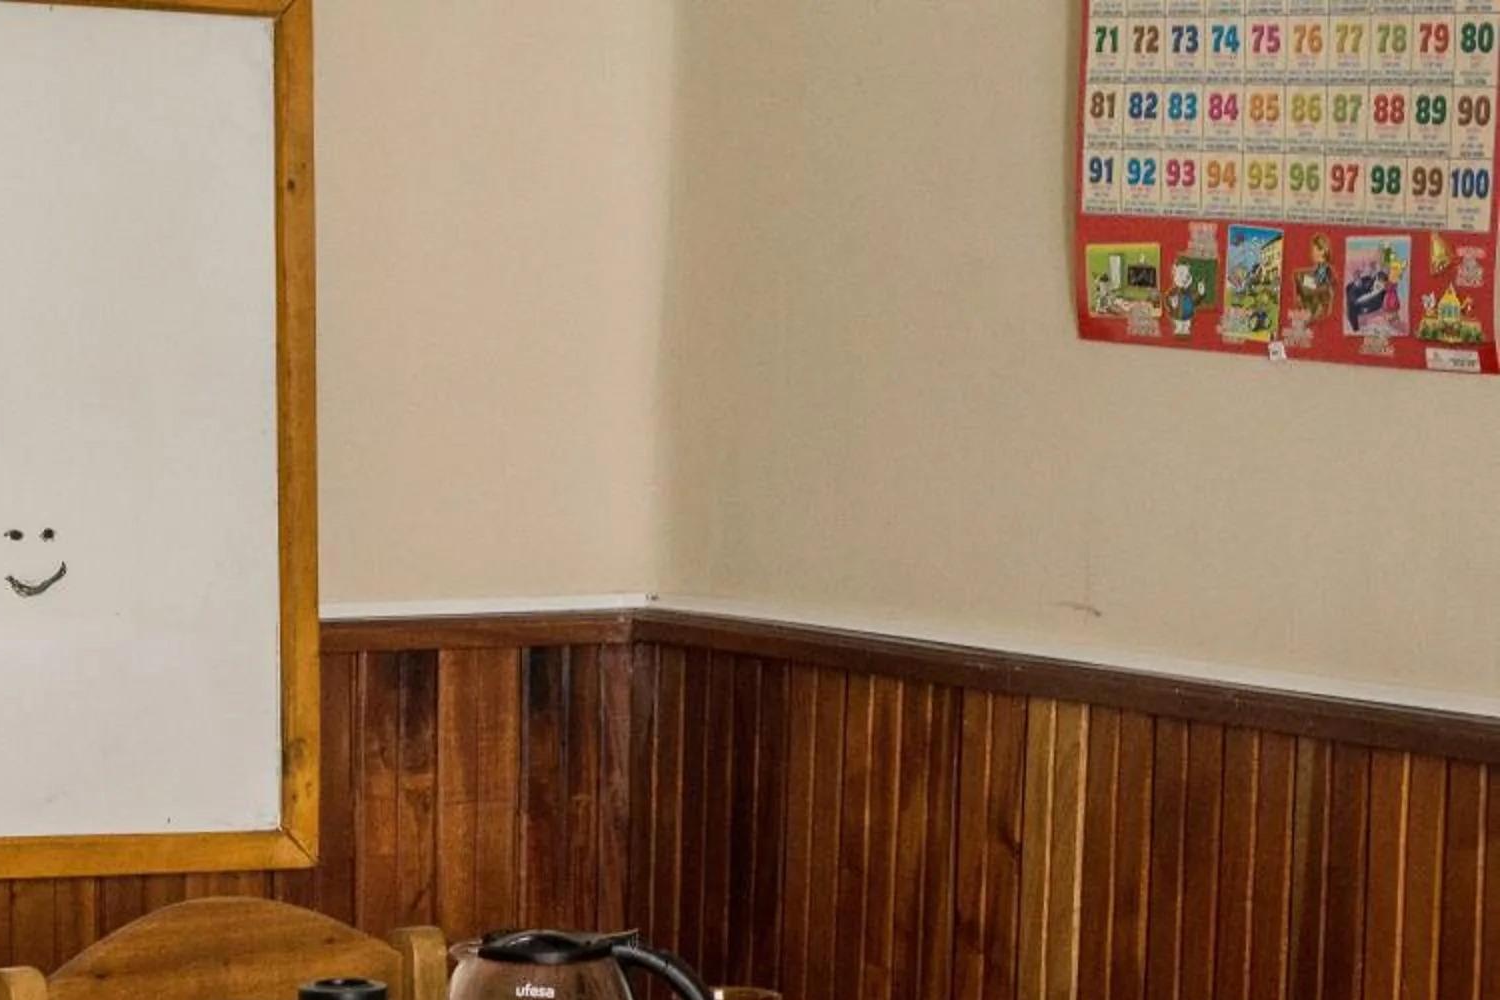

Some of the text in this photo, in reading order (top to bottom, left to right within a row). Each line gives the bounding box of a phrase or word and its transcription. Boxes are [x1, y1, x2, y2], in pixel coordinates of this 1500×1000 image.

[1095, 22, 1494, 53] 71 72 73 74 75 76 77 78 79 80
[1090, 91, 1491, 126] 81 82 83 84 85 86 87 88 89 90
[1089, 157, 1489, 199] 91 92 93 94 95 96 97 98 99 100
[515, 982, 556, 999] ufesa
